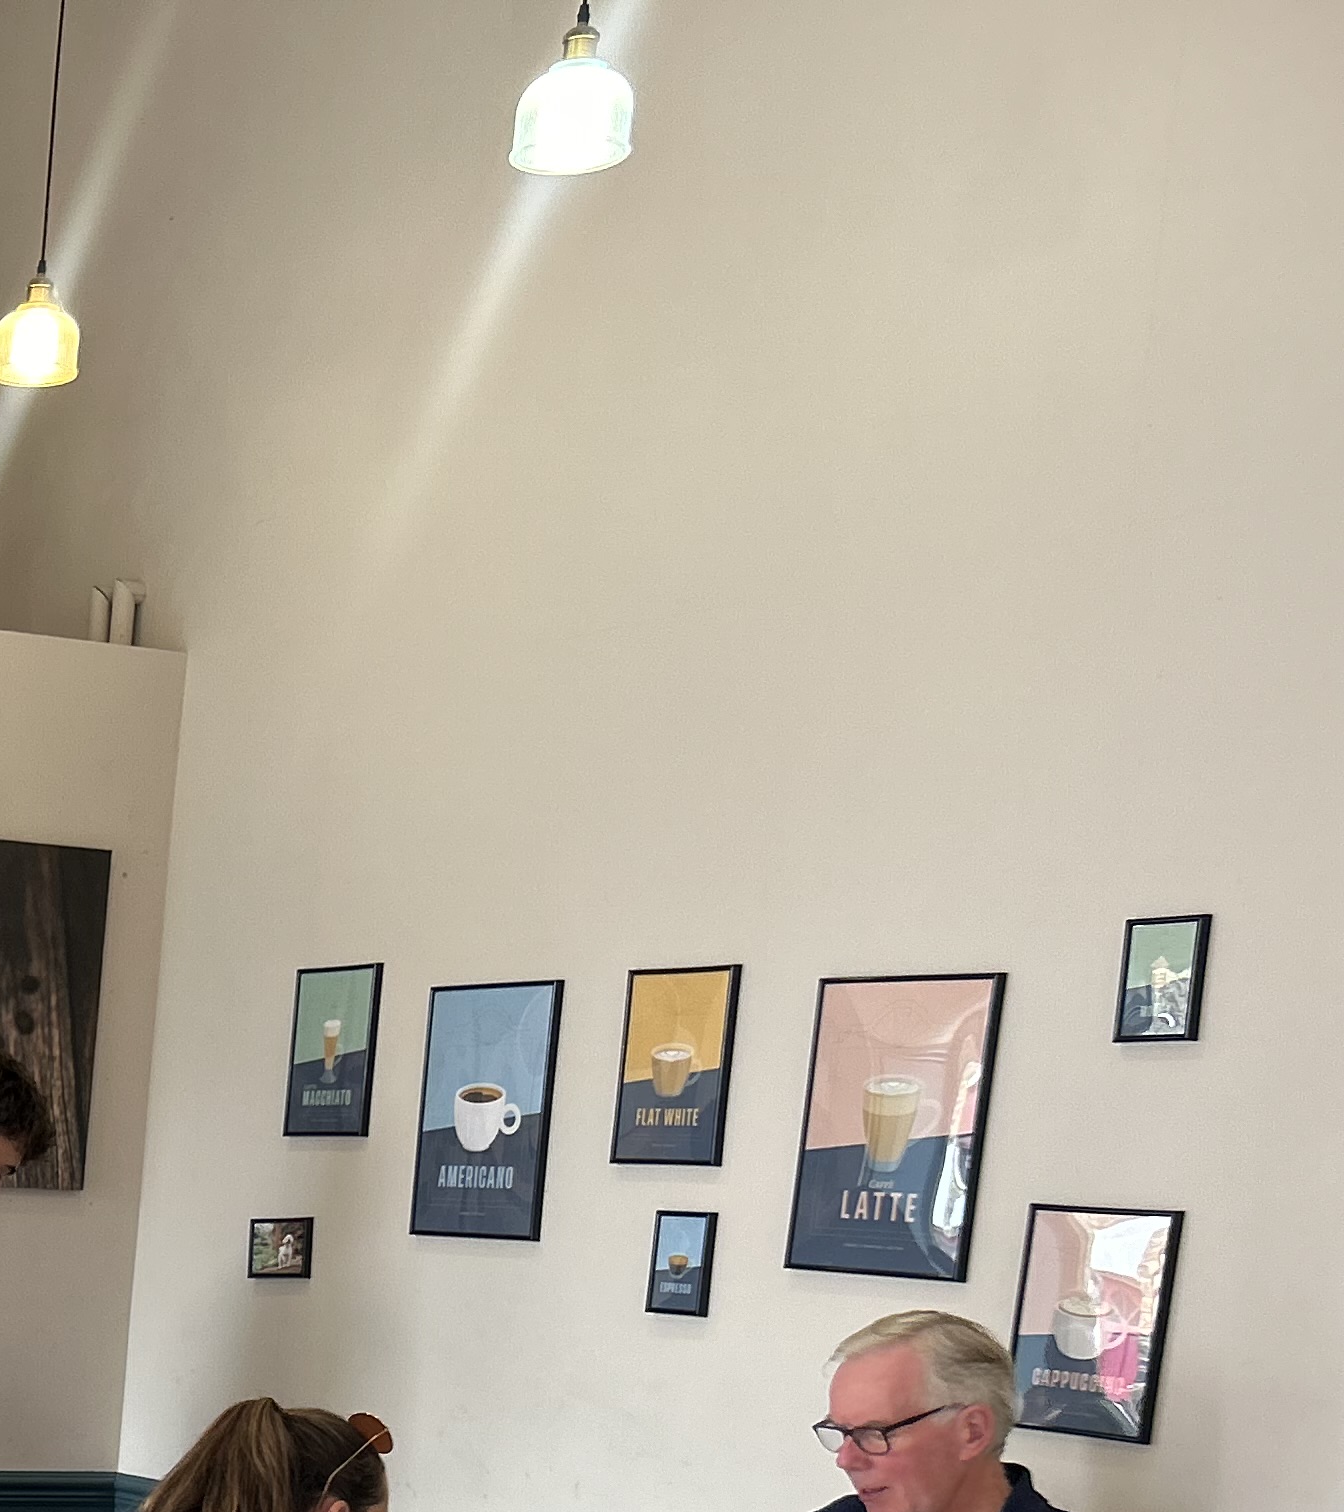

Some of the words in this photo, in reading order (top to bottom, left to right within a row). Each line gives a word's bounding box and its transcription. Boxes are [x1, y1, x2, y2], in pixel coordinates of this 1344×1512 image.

[301, 1086, 353, 1108] MACCHIATO
[634, 1106, 661, 1127] FLAT
[663, 1106, 699, 1128] WHITE
[436, 1163, 515, 1191] AMERICANO
[838, 1189, 919, 1225] LATTE
